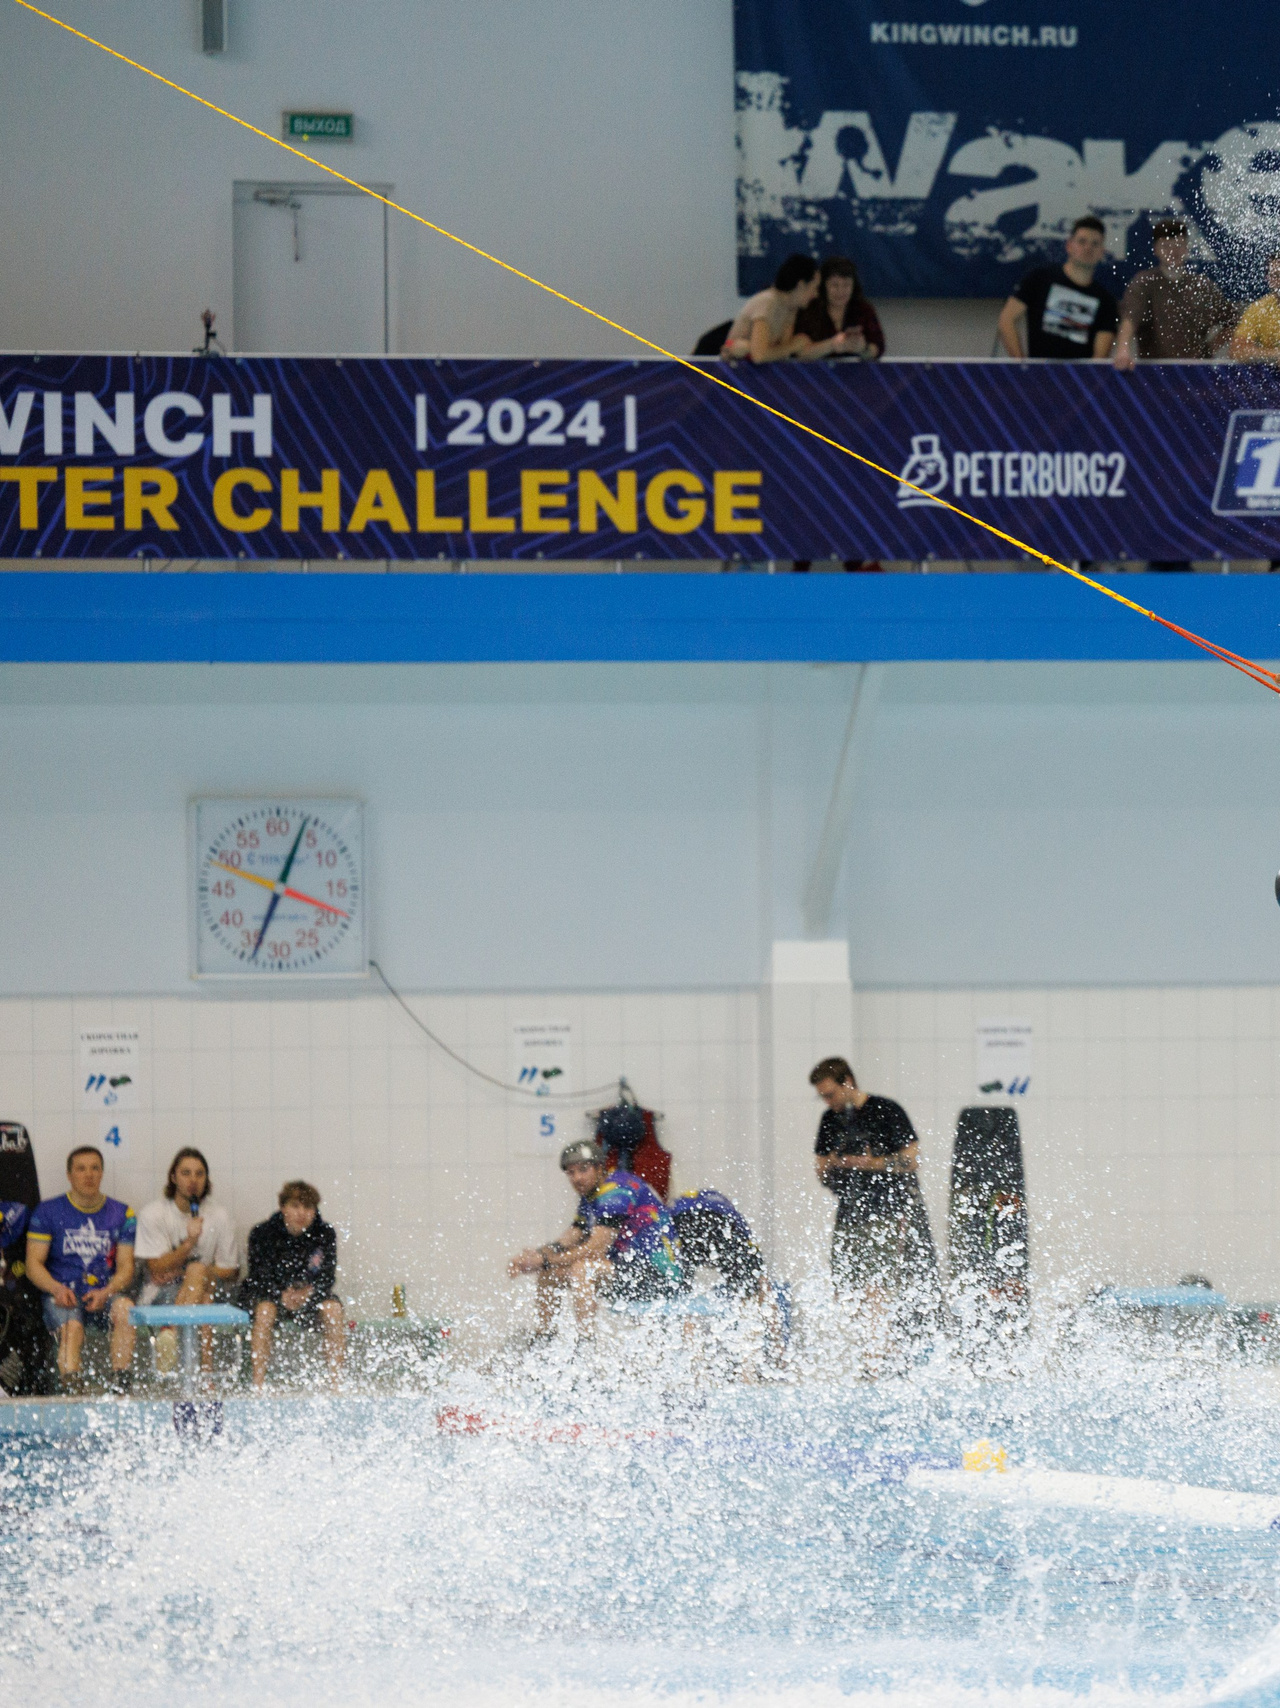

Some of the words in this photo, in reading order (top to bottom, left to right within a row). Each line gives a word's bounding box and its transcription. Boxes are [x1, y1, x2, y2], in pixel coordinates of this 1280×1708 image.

[870, 22, 1079, 48] KINGWINCH.RU
[293, 117, 347, 134] ВЫХОД
[212, 467, 763, 535] CHALLENGE
[266, 817, 290, 837] 60
[236, 830, 260, 848] 55
[305, 829, 317, 848] 5
[219, 850, 242, 869] 50
[316, 849, 337, 868] 10
[211, 879, 236, 899] 45
[326, 878, 348, 898] 15
[219, 909, 243, 928] 40
[314, 908, 338, 927] 20
[295, 928, 319, 948] 25
[267, 941, 291, 960] 30
[540, 1114, 555, 1136] 5
[105, 1125, 121, 1147] 4
